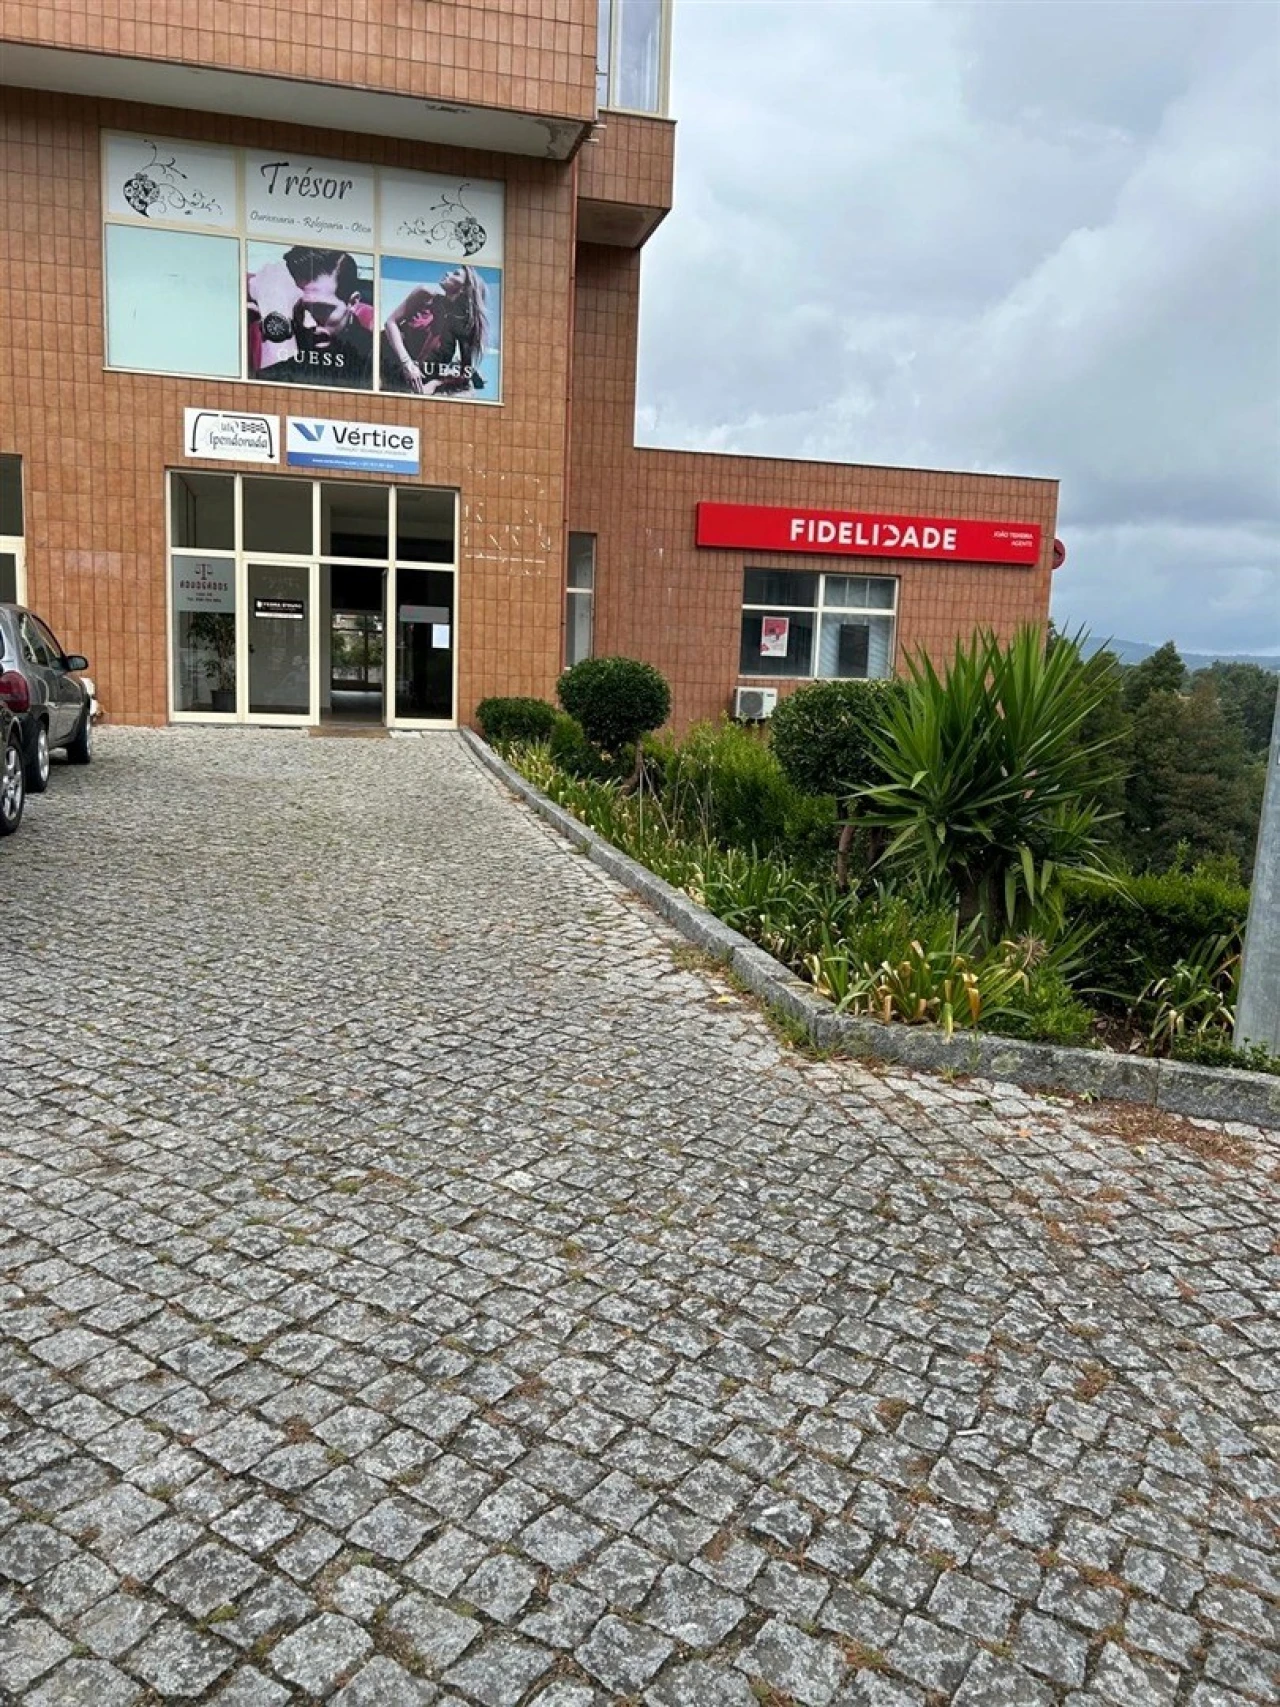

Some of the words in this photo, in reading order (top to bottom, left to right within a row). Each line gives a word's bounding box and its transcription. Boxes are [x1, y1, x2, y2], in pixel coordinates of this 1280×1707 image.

[260, 161, 353, 200] Trésor
[414, 360, 473, 379] UESS
[332, 426, 415, 450] Vértice
[790, 517, 958, 552] FIDELIDADE
